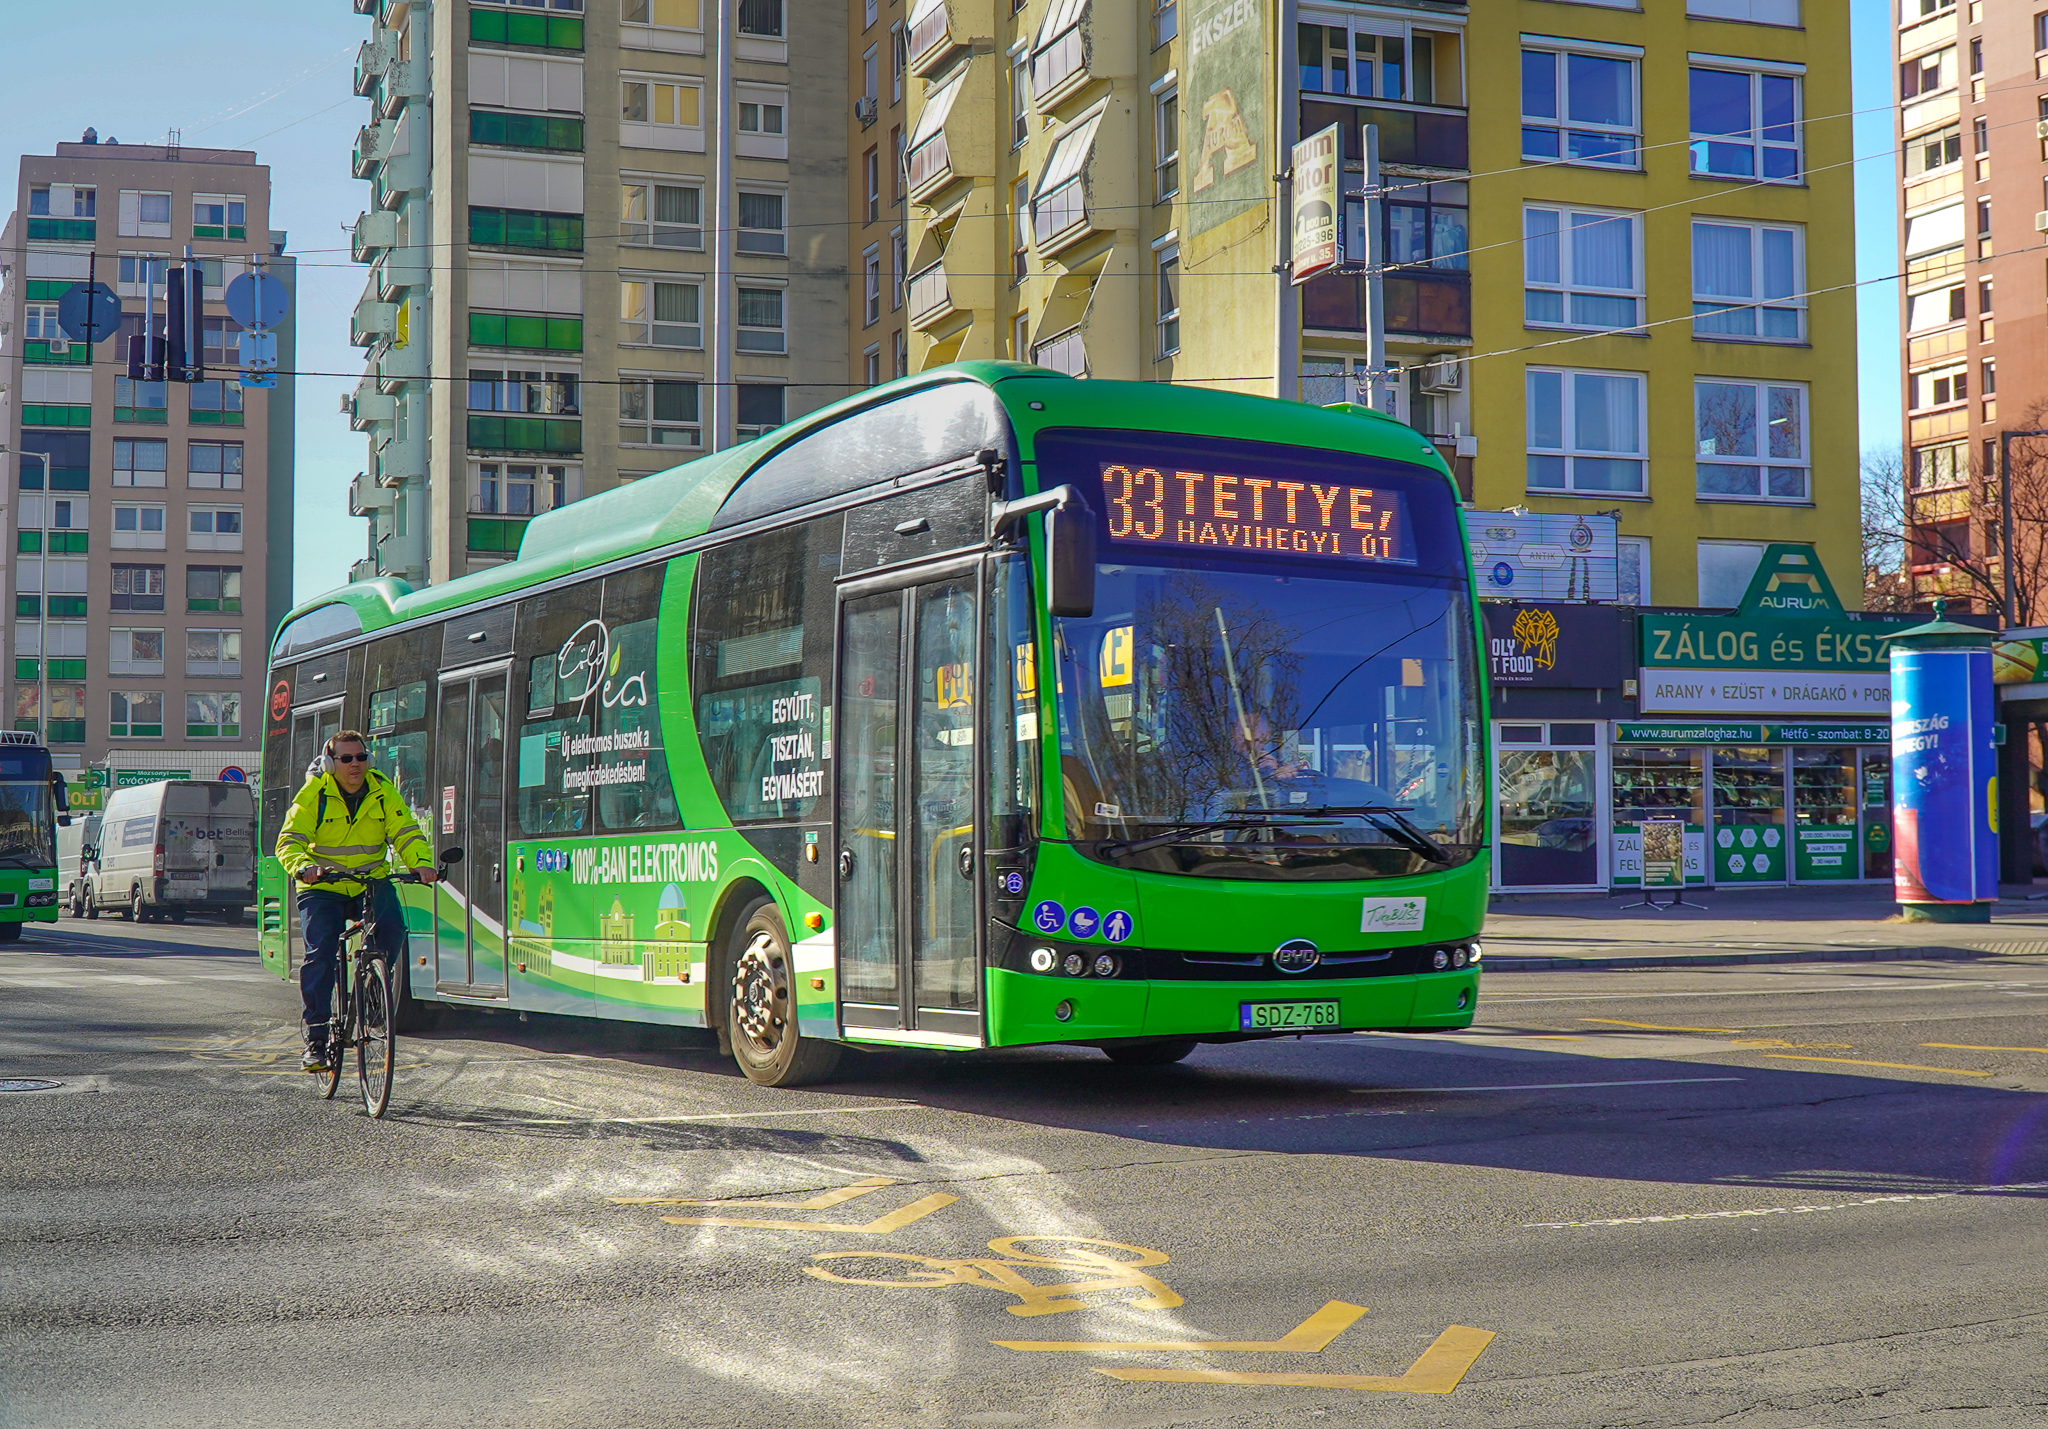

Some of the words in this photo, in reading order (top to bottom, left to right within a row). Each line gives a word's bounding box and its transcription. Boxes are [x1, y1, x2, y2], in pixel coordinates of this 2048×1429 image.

[1192, 0, 1256, 56] ÉKSZER
[1102, 464, 1165, 540] 33
[1175, 471, 1394, 532] TETTYE,
[1177, 520, 1341, 555] HAVIHEGYI
[1529, 551, 1556, 560] ANTIK
[1759, 596, 1830, 610] AURUM
[1653, 623, 1758, 661] ZÁLOG
[1770, 633, 1804, 662] és
[1502, 656, 1534, 674] FOOD
[772, 690, 814, 724] EGYÜTT,
[1655, 684, 1704, 699] ARANY
[1722, 682, 1765, 700] EZÜST
[1783, 684, 1847, 701] DRÁGAKŐ
[1864, 688, 1891, 702] POR
[562, 730, 570, 762] Új
[571, 733, 612, 756] elektromos
[614, 726, 643, 750] buszok
[770, 733, 814, 762] TISZTÁN,
[1632, 728, 1752, 742] www.aurumzaloghaz.hu
[1781, 728, 1809, 740] Hétfő
[1818, 728, 1862, 740] szombat:
[564, 760, 646, 792] tömegközlekedésben!
[762, 768, 824, 802] EGYMÁSÉRT
[196, 827, 224, 840] bet
[226, 828, 250, 836] Bellis
[570, 844, 627, 886] 100%-BAN
[629, 841, 718, 883] ELEKTROMOS
[1279, 950, 1316, 964] BYD
[1256, 1004, 1335, 1026] SDZ-768
